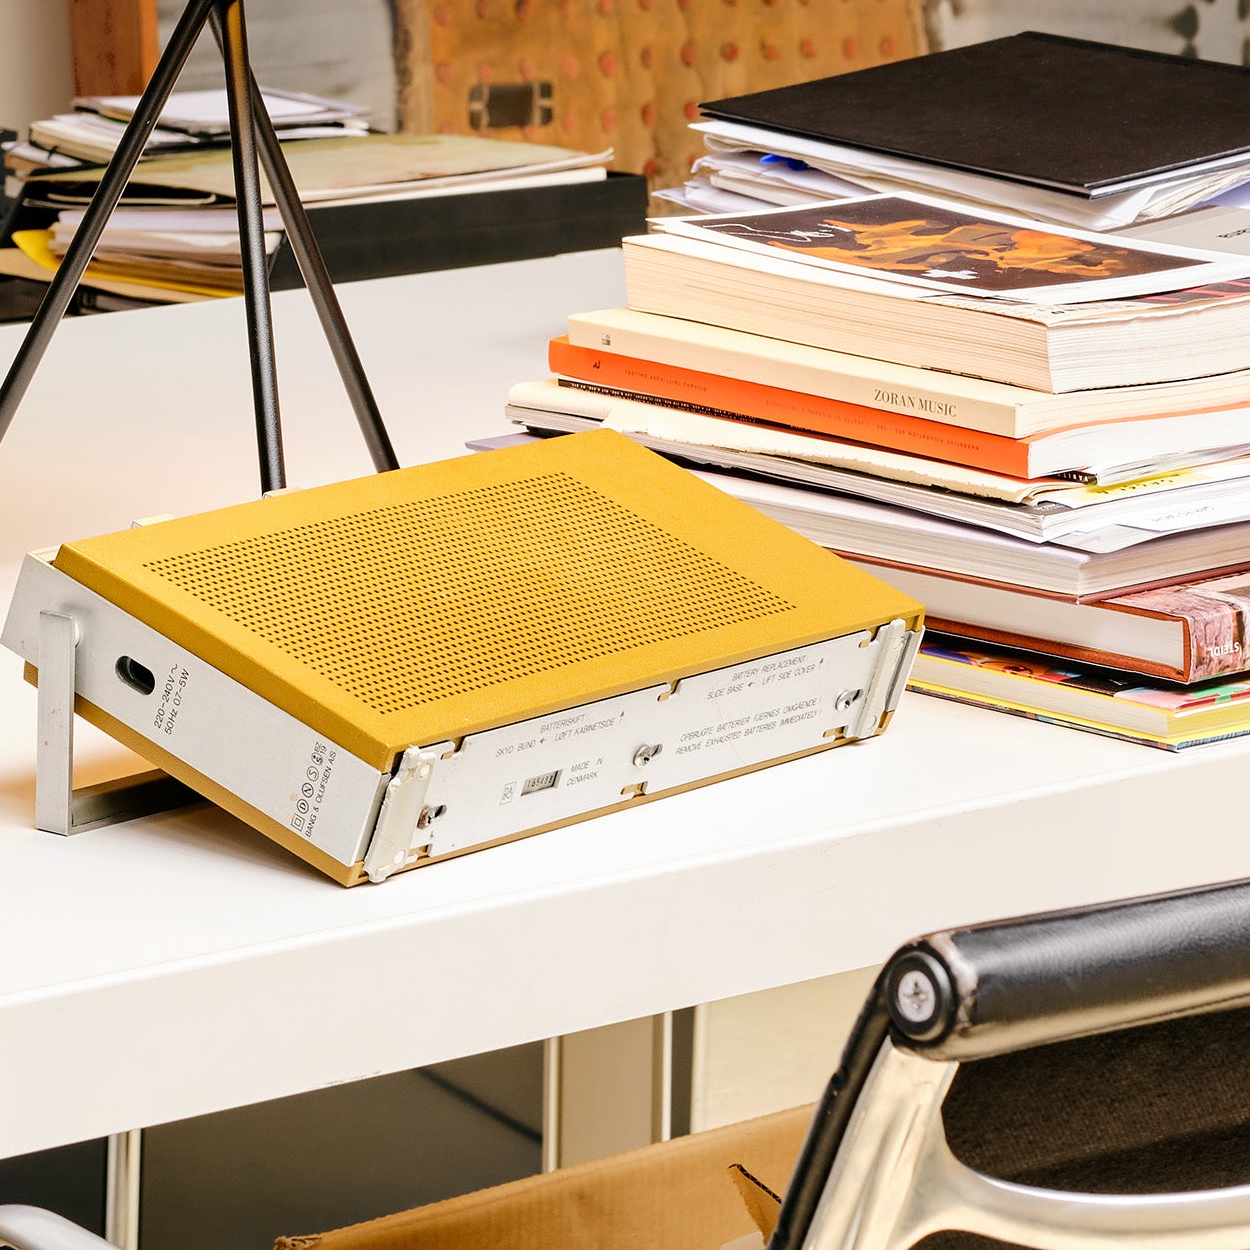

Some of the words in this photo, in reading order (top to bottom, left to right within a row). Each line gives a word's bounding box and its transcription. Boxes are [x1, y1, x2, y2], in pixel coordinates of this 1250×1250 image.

[873, 388, 916, 409] ZORAN
[918, 398, 957, 418] MUSIC
[1207, 641, 1240, 657] STEIDL
[707, 687, 724, 700] SLIDE
[727, 682, 745, 696] BASE
[762, 674, 776, 686] LIFT
[778, 669, 792, 681] SIDE
[794, 664, 815, 677] COVER
[732, 667, 759, 682] BATTERY
[761, 655, 806, 674] REPLACEMENT
[164, 708, 179, 736] 50Hz
[517, 739, 537, 753] BUND
[675, 740, 702, 756] REMOVE
[705, 730, 742, 748] EXHAUSTED
[744, 721, 777, 737] BATTERIES
[570, 759, 591, 773] MADE
[596, 756, 605, 766] IN
[566, 770, 599, 787] DENMARK
[304, 813, 317, 838] BANG
[315, 765, 332, 804] OLUFSEN
